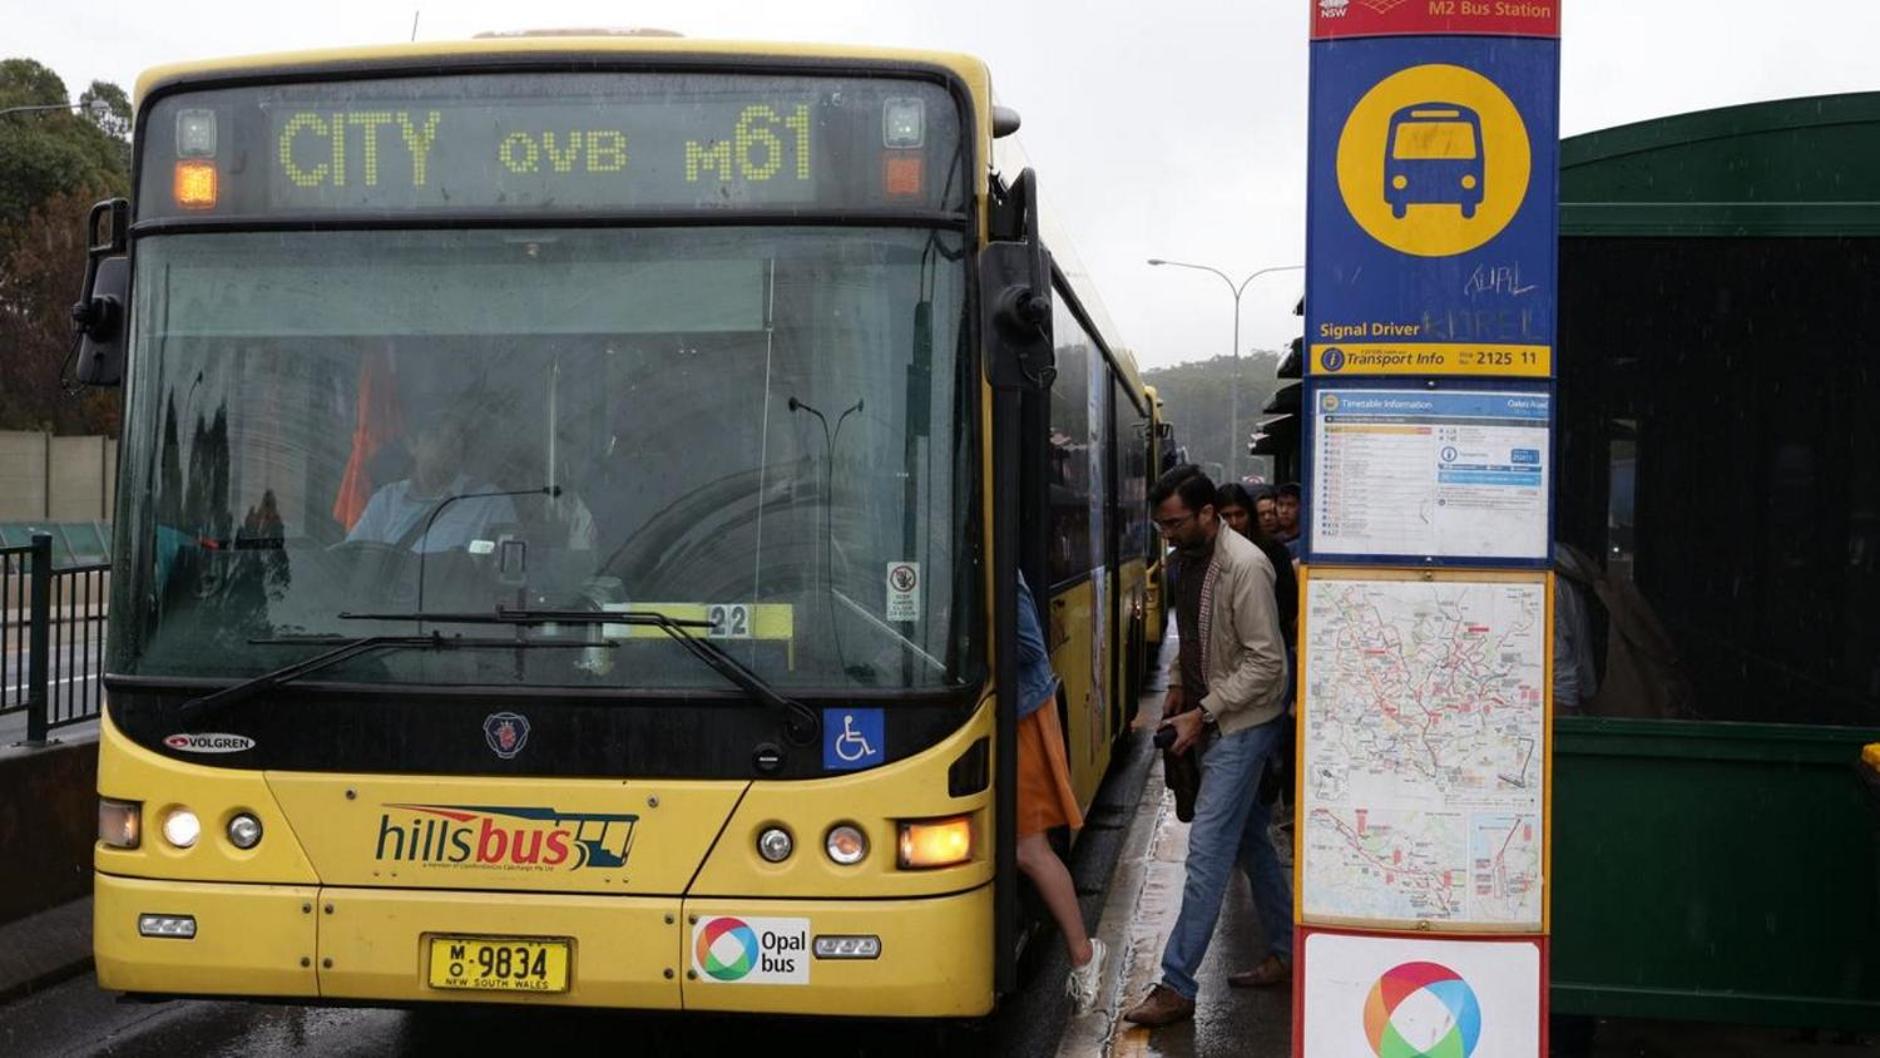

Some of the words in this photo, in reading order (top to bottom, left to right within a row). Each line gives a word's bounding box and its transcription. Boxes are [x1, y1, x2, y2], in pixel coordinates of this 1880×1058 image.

[1321, 8, 1347, 18] NSW
[1428, 1, 1456, 15] M2
[1461, 1, 1490, 16] Bus
[1495, 2, 1551, 18] Station
[280, 112, 441, 187] CITY
[499, 131, 628, 173] QVB
[686, 104, 810, 182] M61
[1320, 322, 1367, 339] Signal
[1371, 321, 1420, 336] Driver
[1347, 351, 1412, 368] Transport
[1416, 351, 1445, 365] Info
[1477, 351, 1513, 365] 2125
[1521, 351, 1537, 364] 11
[1342, 398, 1381, 409] Timetable
[1383, 399, 1433, 410] Information
[711, 605, 746, 636] 22
[190, 737, 249, 749] VOLGREN
[375, 814, 571, 865] hillsbus
[761, 931, 806, 954] Opal
[478, 946, 547, 980] 9834
[761, 954, 795, 973] bus
[445, 978, 468, 986] NEW
[474, 979, 509, 988] SOUTH
[515, 980, 549, 989] WALES
